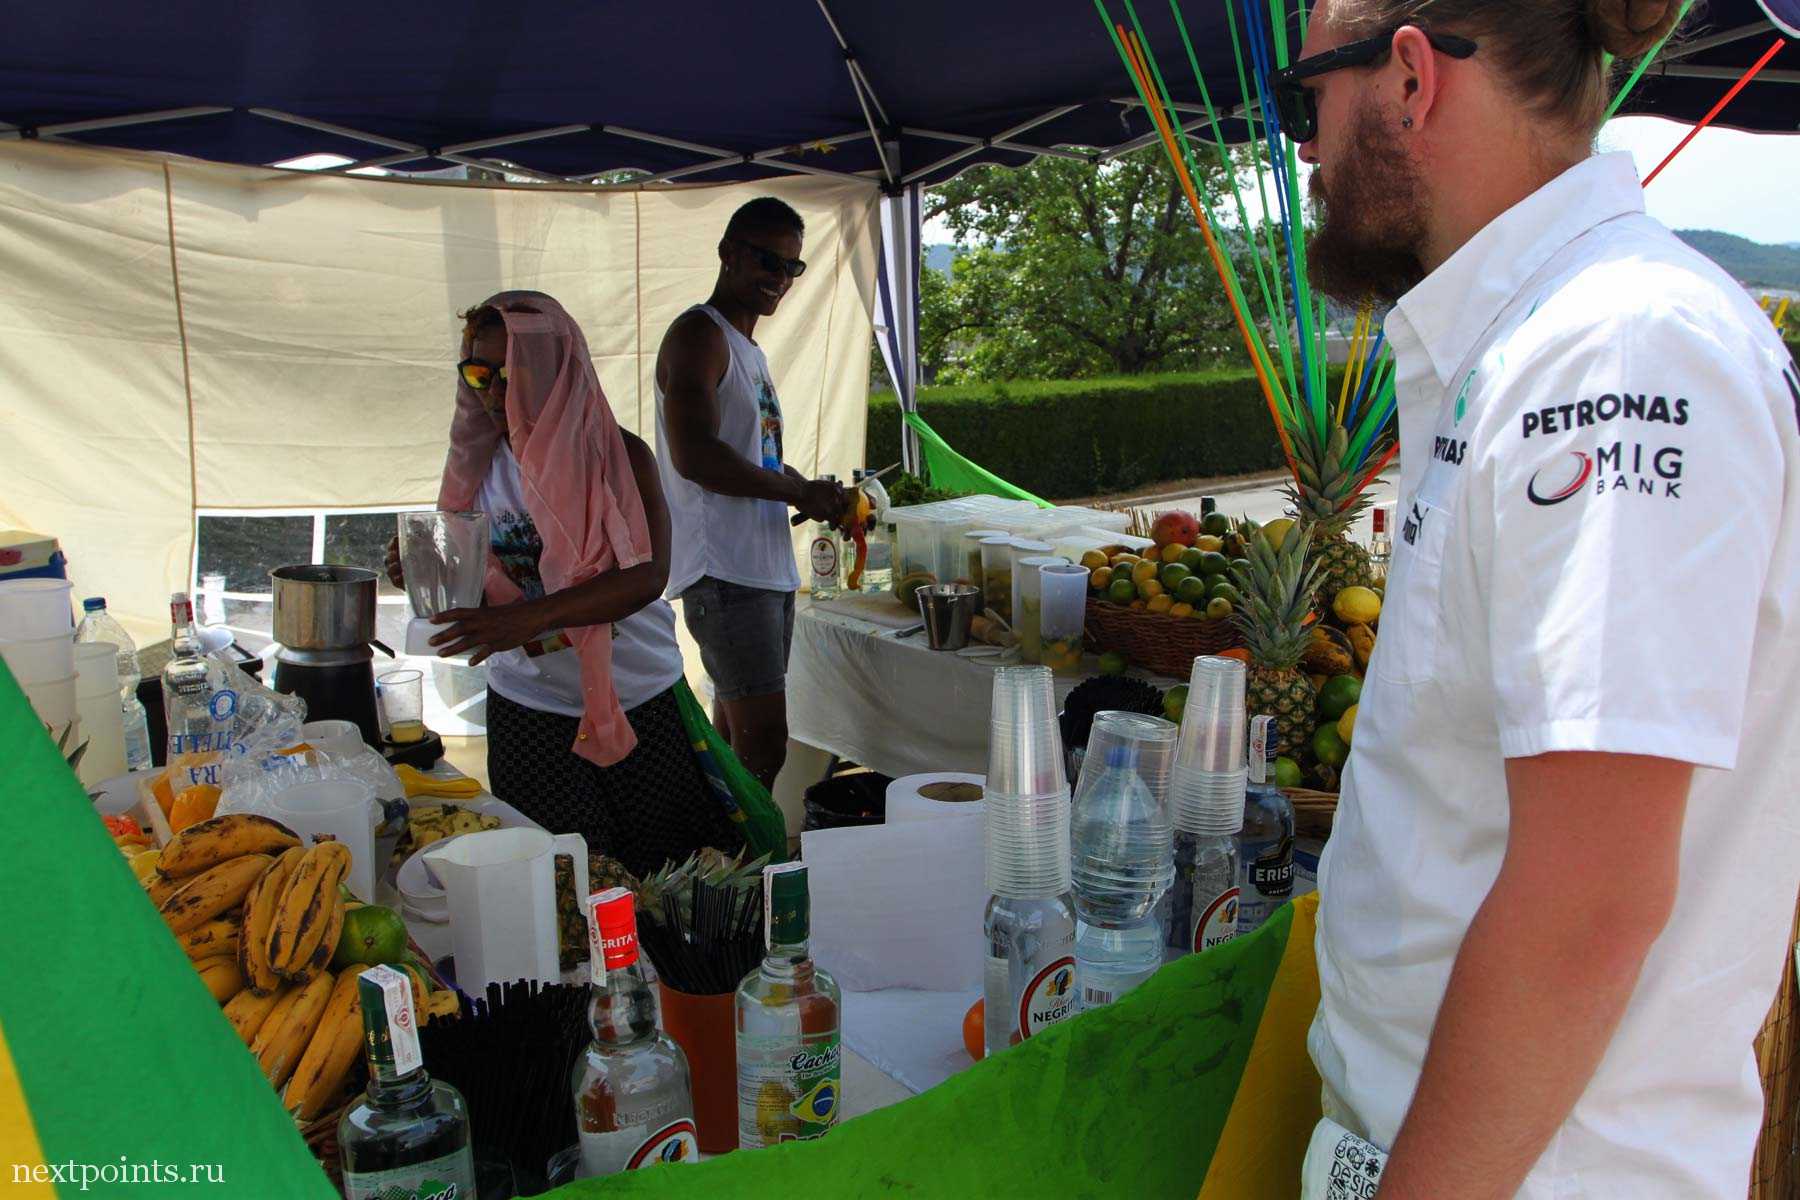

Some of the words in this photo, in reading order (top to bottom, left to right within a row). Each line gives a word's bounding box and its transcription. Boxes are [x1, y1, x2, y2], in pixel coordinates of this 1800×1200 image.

[1522, 393, 1689, 438] PETRONAS
[1597, 441, 1683, 480] MIG
[1596, 474, 1682, 499] BANK
